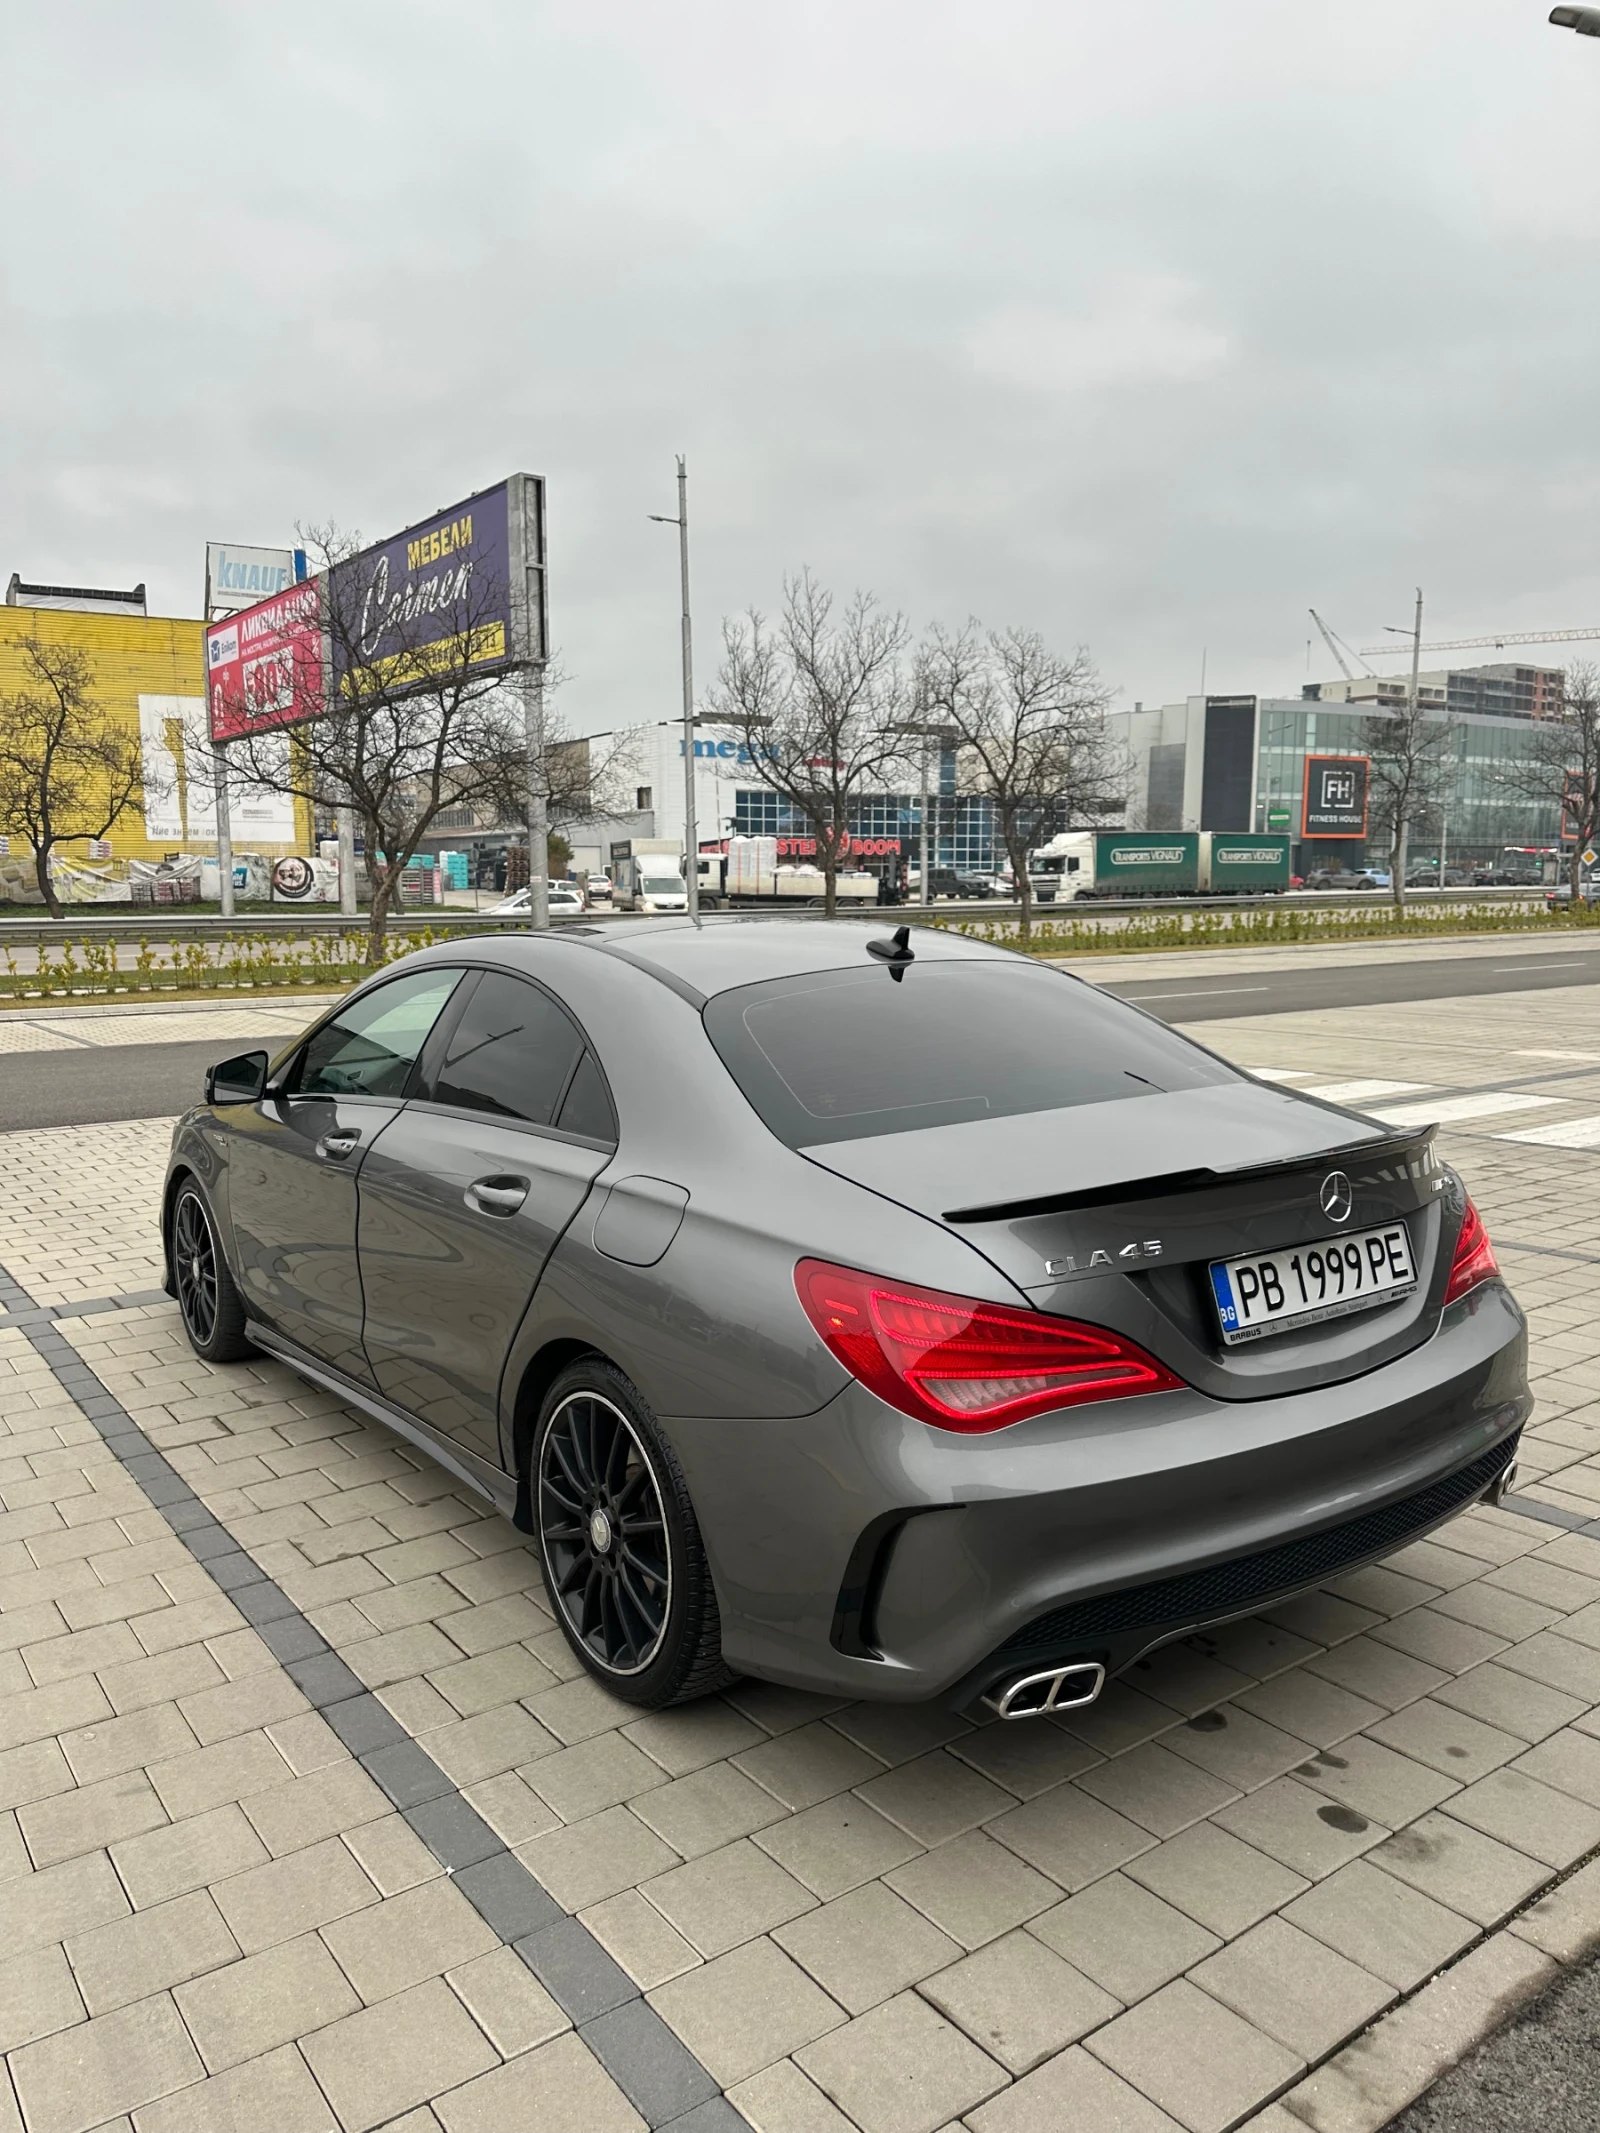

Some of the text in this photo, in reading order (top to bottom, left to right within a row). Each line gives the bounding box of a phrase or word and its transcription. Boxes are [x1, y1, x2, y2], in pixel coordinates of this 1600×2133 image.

[407, 515, 472, 571] МЕБЕЛИ
[217, 551, 287, 592] KNAUF
[1327, 780, 1350, 799] FH
[1309, 815, 1362, 823] FITNESS HOUSE
[852, 839, 901, 855] BOOM
[1044, 1240, 1163, 1276] CLA 45
[1235, 1232, 1409, 1318] PB 1999 PE
[1220, 1306, 1235, 1323] BG
[1230, 1328, 1262, 1342] BRABUS
